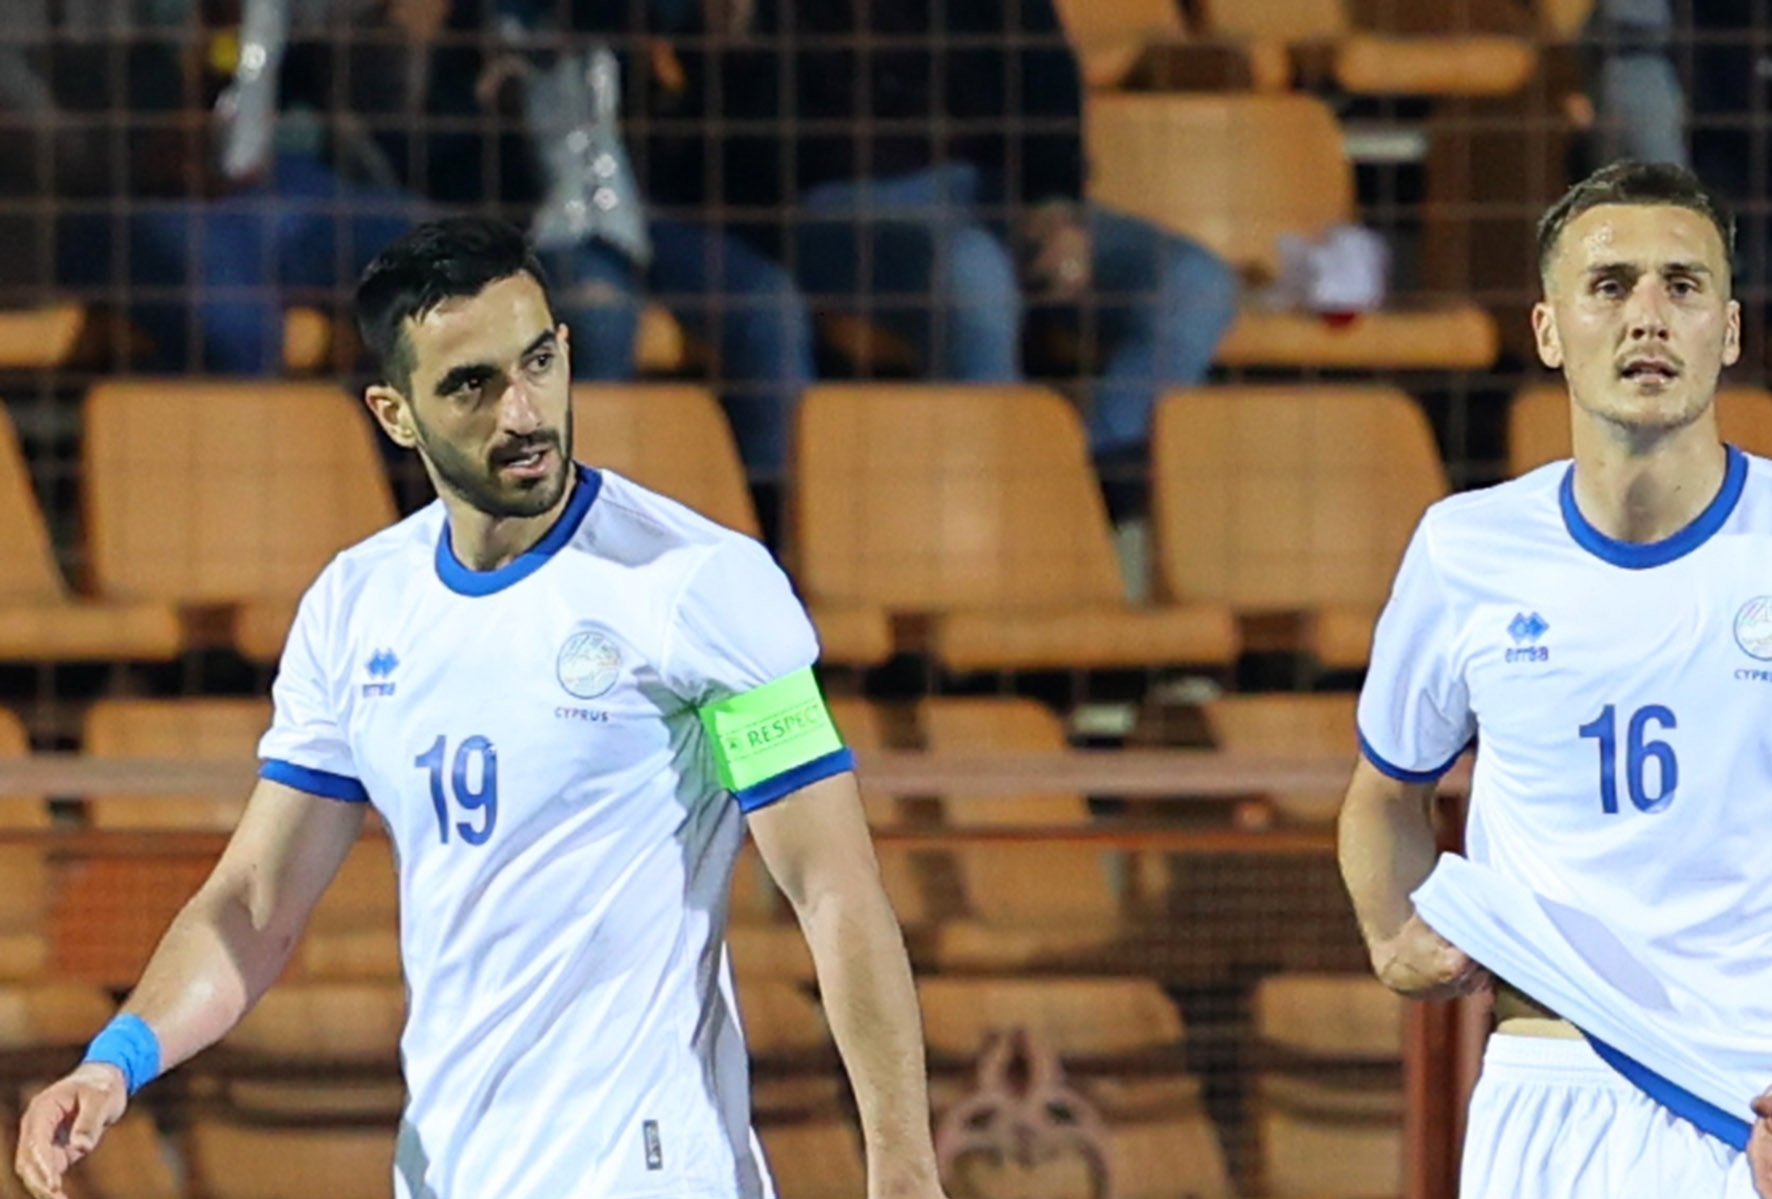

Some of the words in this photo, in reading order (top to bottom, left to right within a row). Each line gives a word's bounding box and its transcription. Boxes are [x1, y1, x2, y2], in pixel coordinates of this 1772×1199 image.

[747, 703, 822, 747] RESPEC
[1578, 703, 1679, 815] 16
[415, 734, 498, 846] 19
